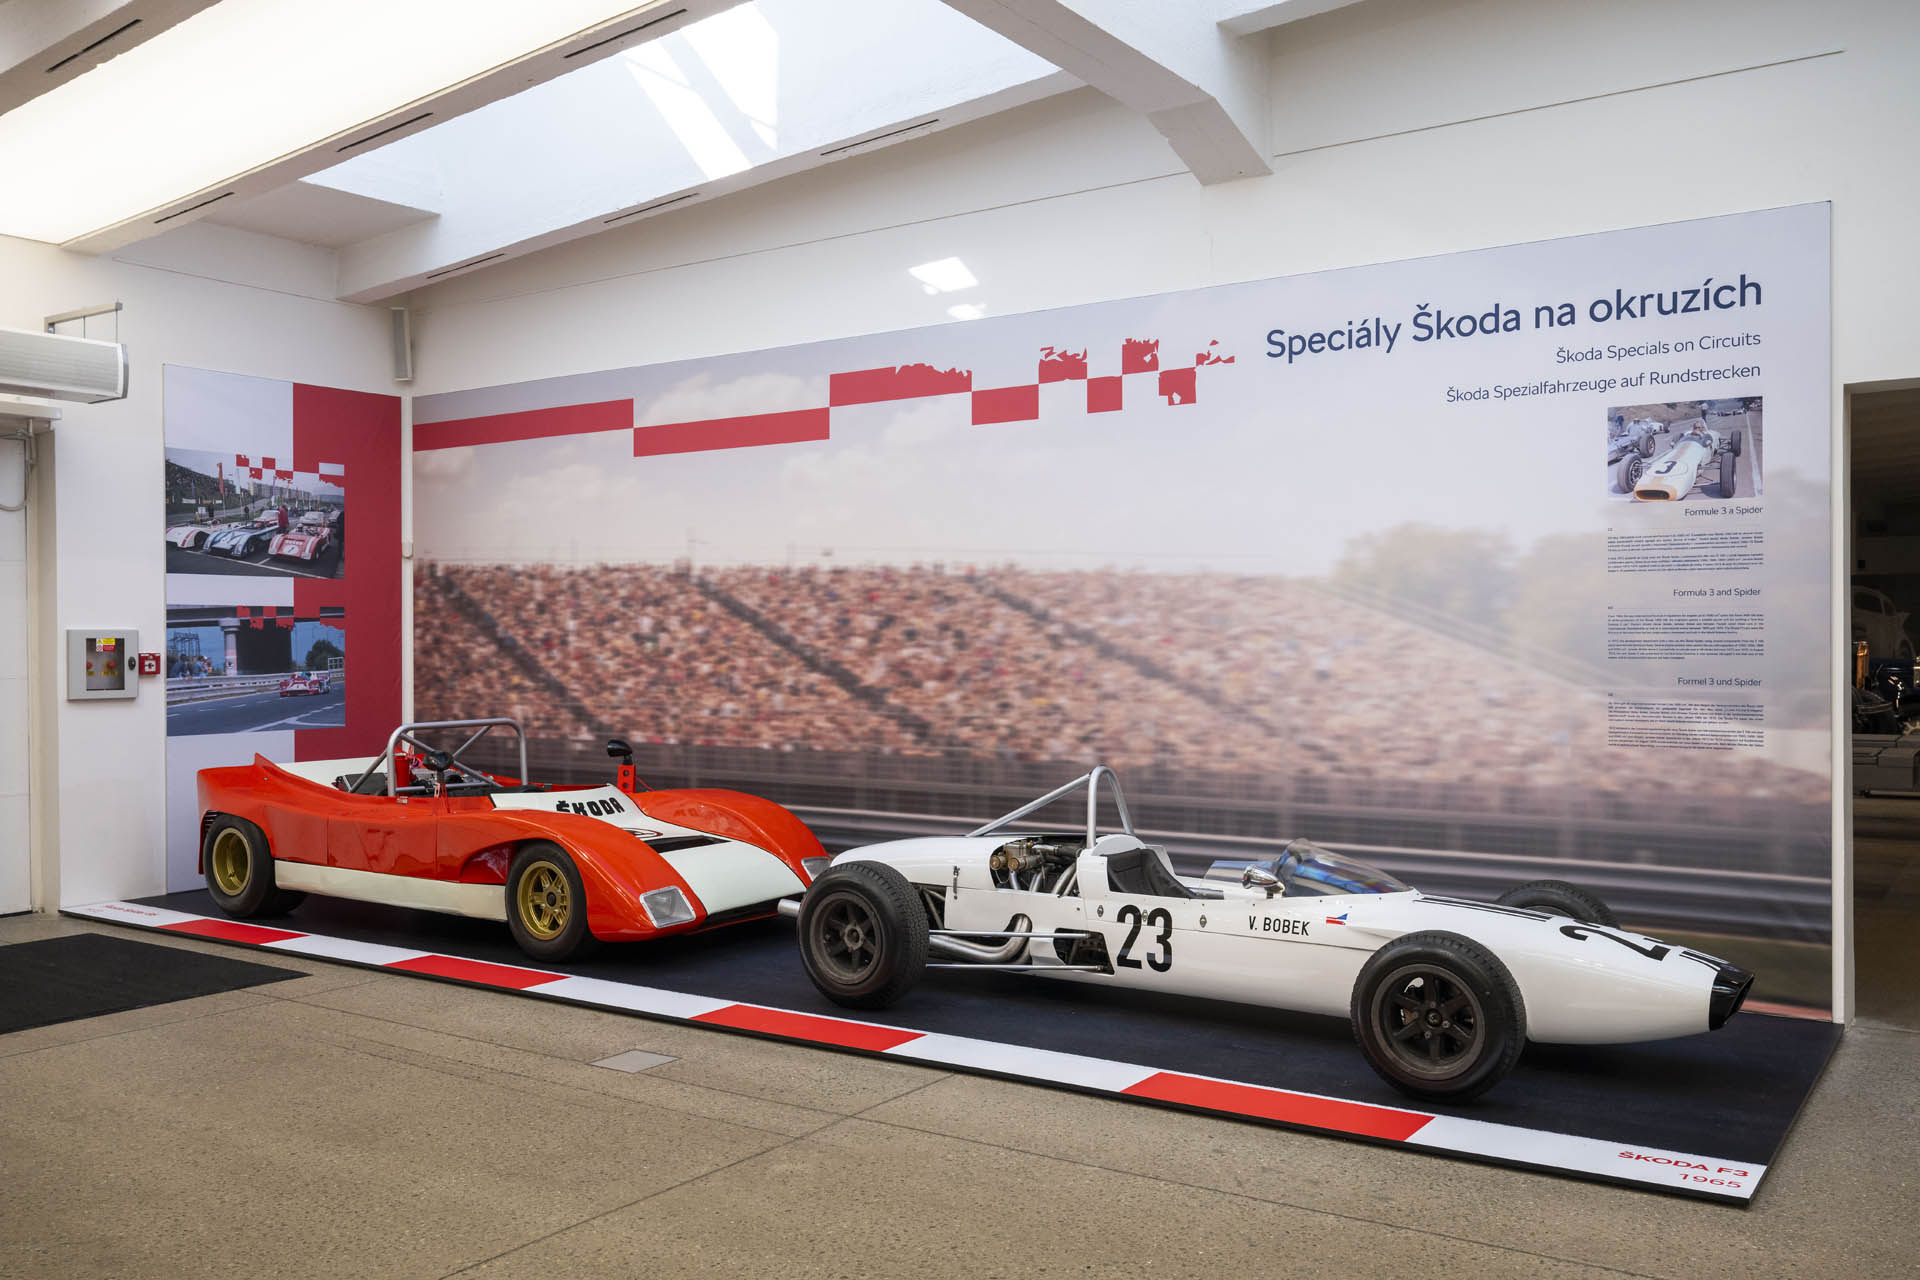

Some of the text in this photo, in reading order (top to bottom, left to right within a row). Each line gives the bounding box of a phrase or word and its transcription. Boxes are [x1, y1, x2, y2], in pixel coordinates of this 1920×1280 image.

[1266, 274, 1762, 364] Speciály Škoda na okruzích
[1556, 332, 1762, 364] Škoda Specials on Circuits
[1446, 364, 1761, 402] Škoda Spezialfahrzeuge auf Rundstrecken
[1684, 507, 1719, 516] Formule
[1722, 507, 1727, 515] 3
[1736, 506, 1763, 516] Spider
[1673, 587, 1761, 599] Formula 3 and Spider
[1677, 677, 1762, 688] Formel 3 und Spider
[556, 797, 625, 816] ŠKODA
[1249, 915, 1310, 936] V. BOBEK
[1116, 904, 1173, 973] 23
[1617, 1150, 1750, 1178] ŠKODA F3
[1680, 1173, 1742, 1189] 1965
